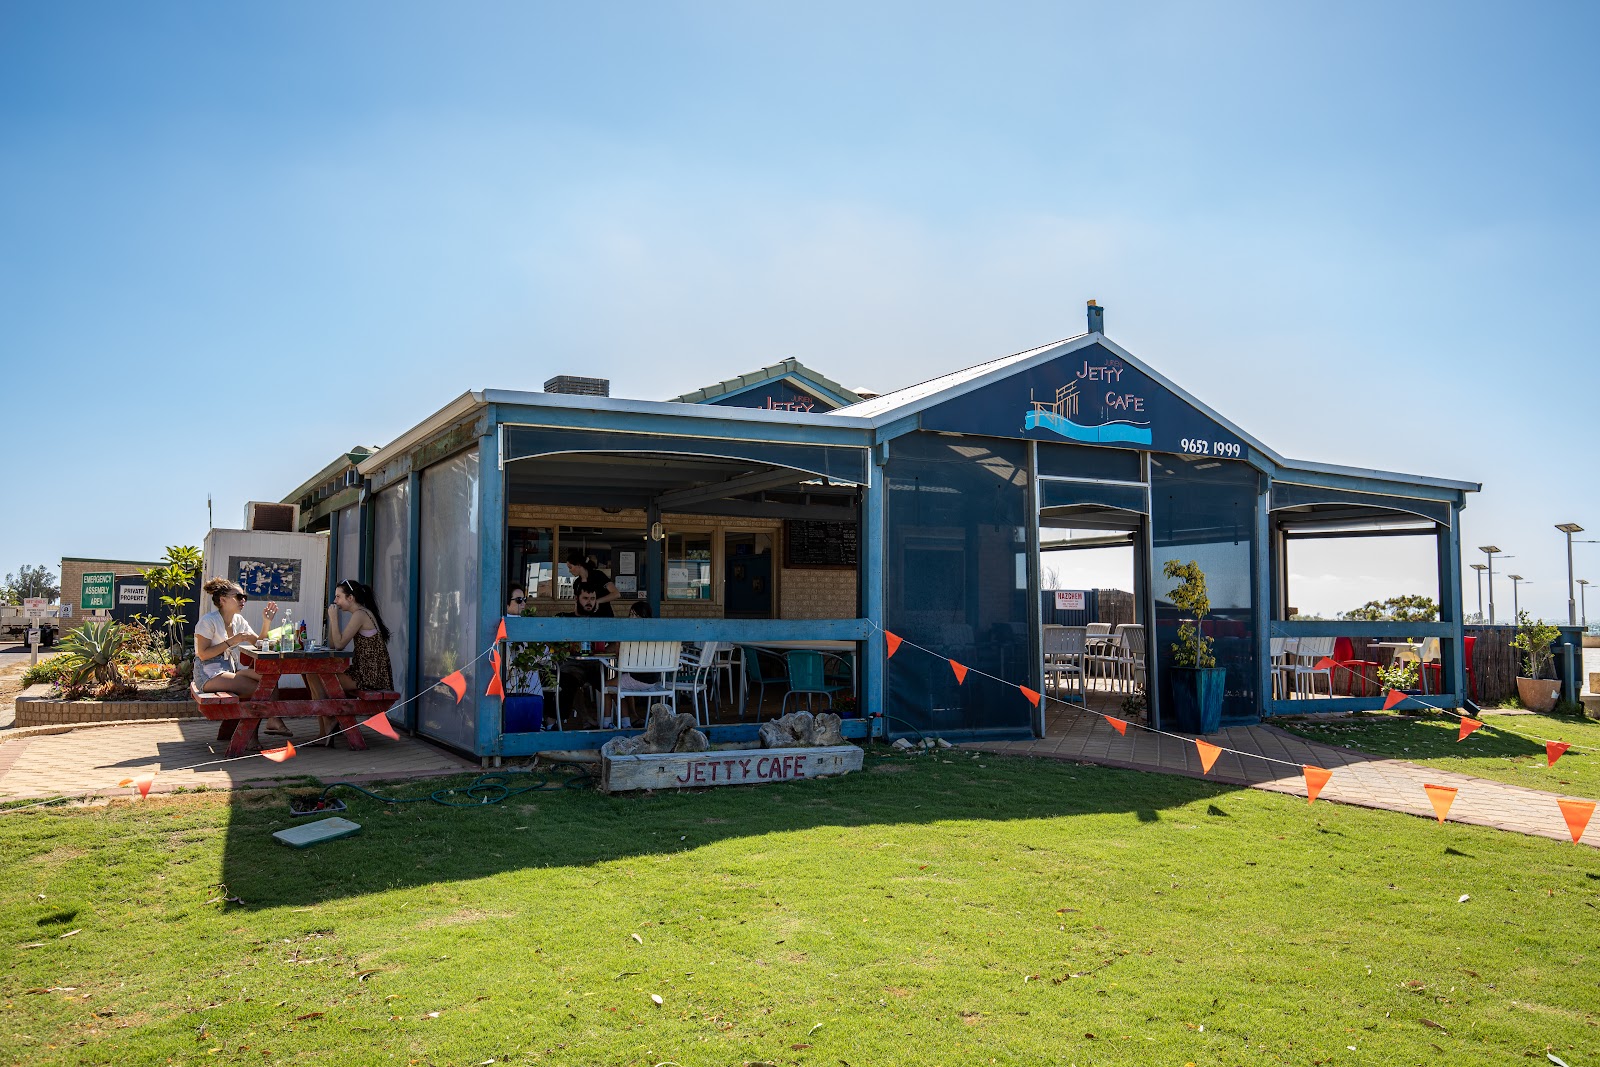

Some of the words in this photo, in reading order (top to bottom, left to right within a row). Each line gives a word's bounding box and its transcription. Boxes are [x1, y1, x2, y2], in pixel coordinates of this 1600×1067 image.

[1076, 360, 1124, 383] JETTY
[1105, 391, 1145, 412] CAFE
[1180, 438, 1209, 454] 9652
[1213, 441, 1241, 457] 1999
[83, 575, 112, 584] EMERGENCY
[85, 586, 110, 595] ASSEMBLY
[90, 597, 104, 606] AREA
[676, 759, 752, 783] JETTY
[756, 756, 807, 779] CAFE
